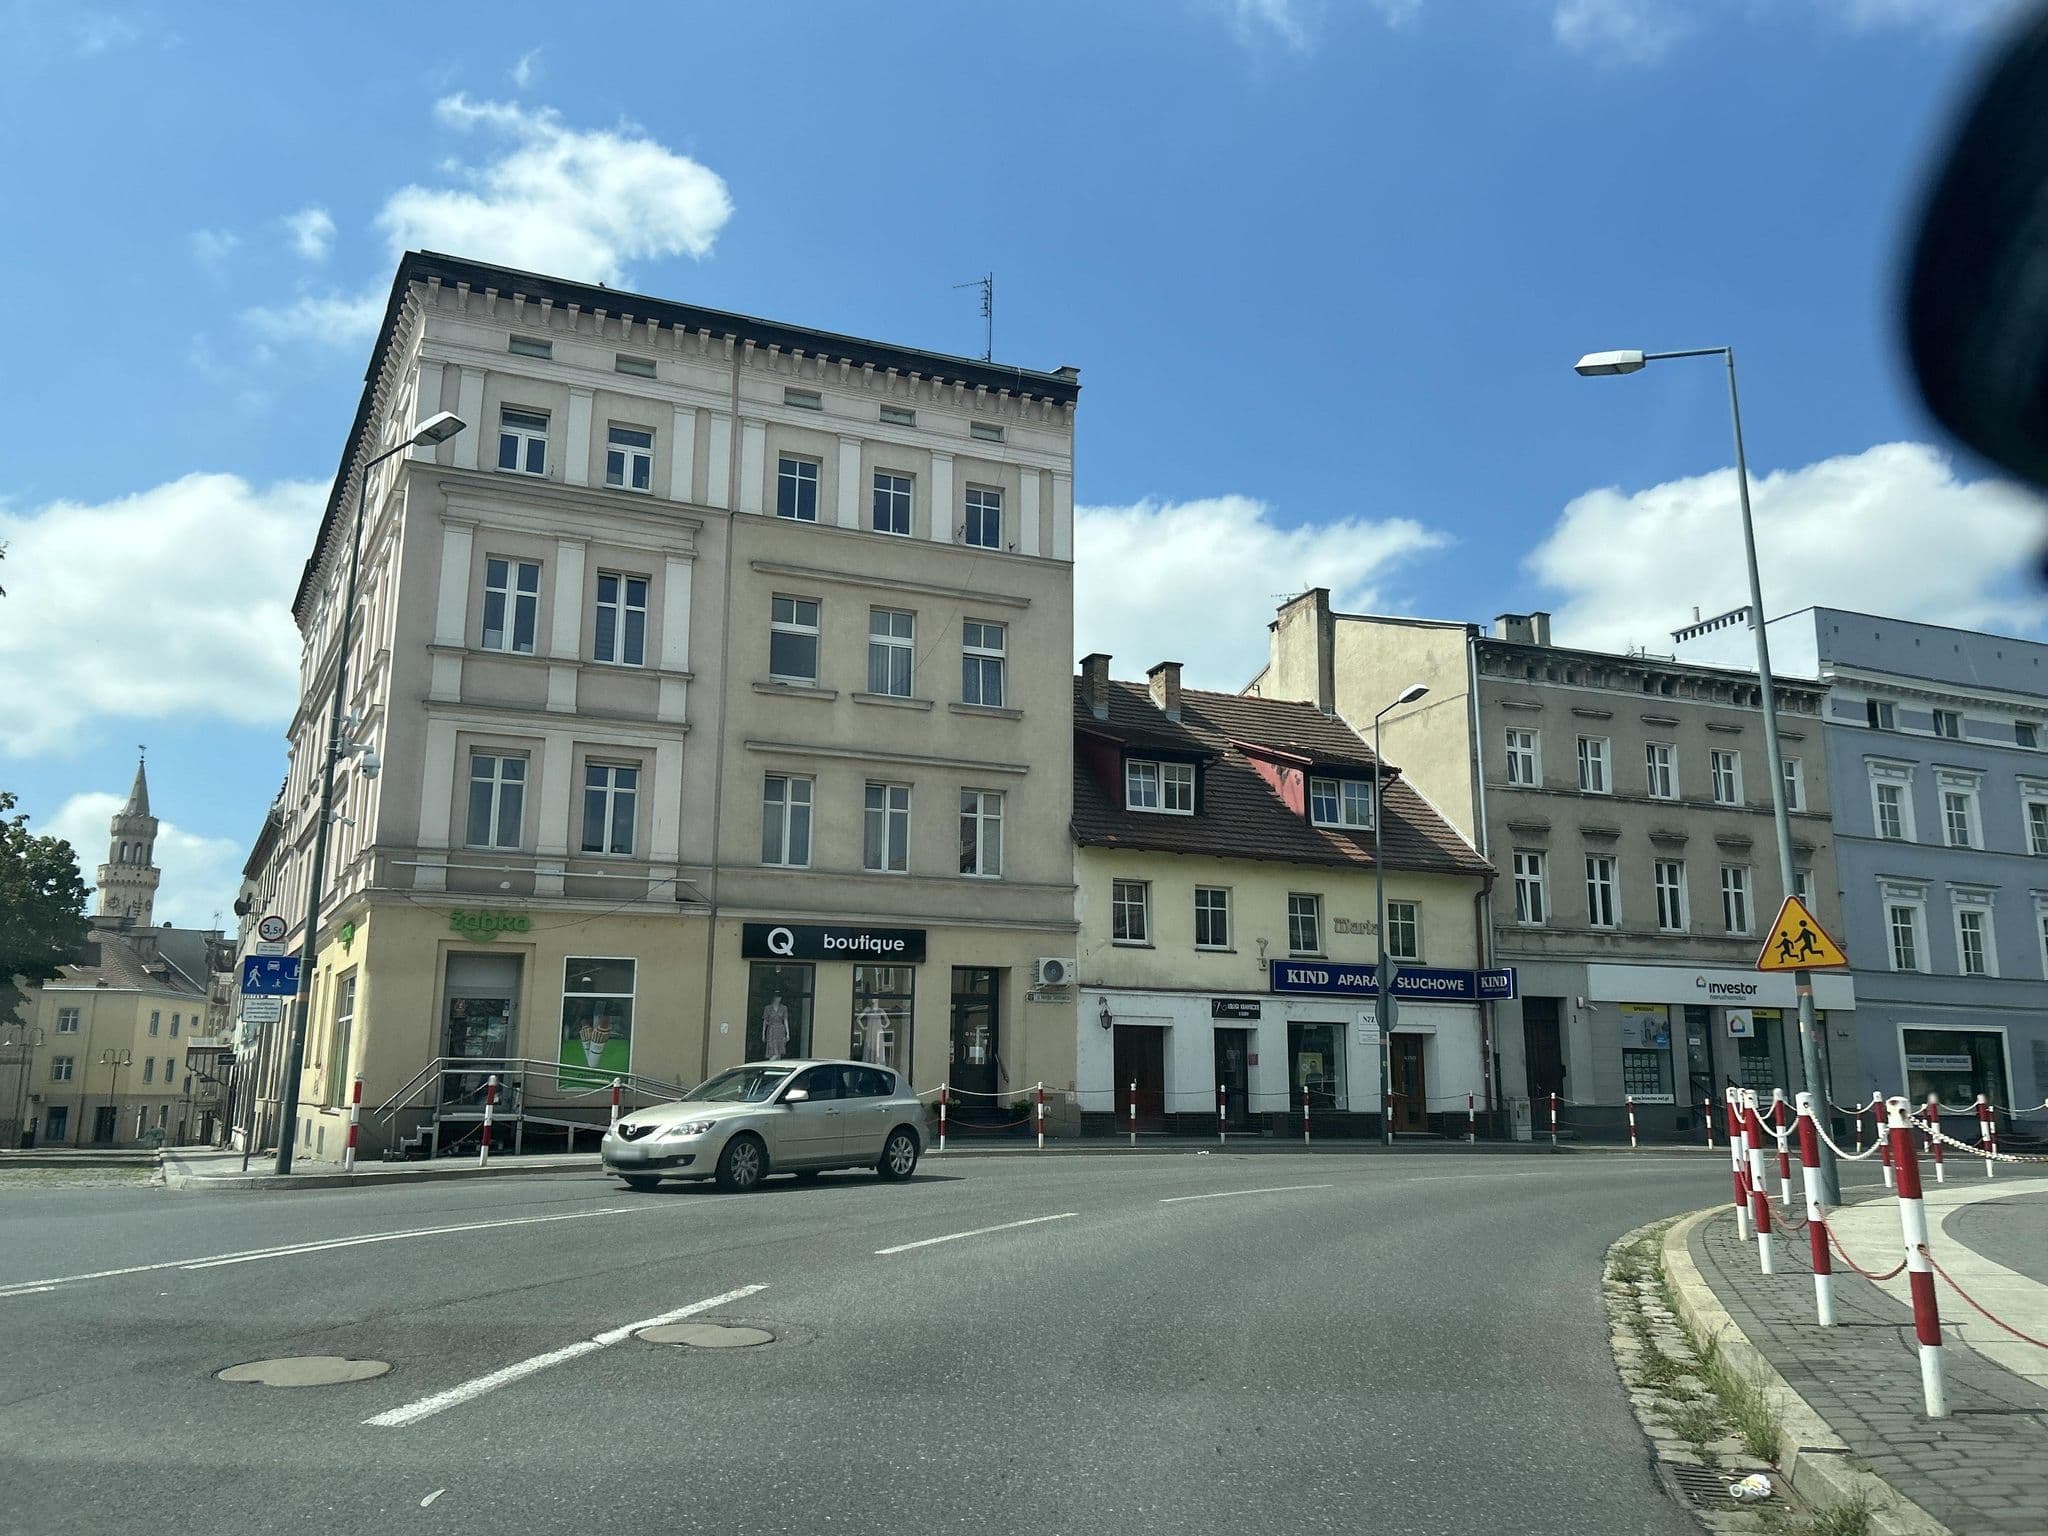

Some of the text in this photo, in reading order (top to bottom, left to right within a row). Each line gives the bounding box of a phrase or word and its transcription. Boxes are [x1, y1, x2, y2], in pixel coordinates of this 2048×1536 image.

[767, 927, 905, 956] Q boutique
[1287, 969, 1465, 991] KIND APARA SŁUCHOWE
[1481, 976, 1507, 988] KIND
[1709, 982, 1758, 995] investor
